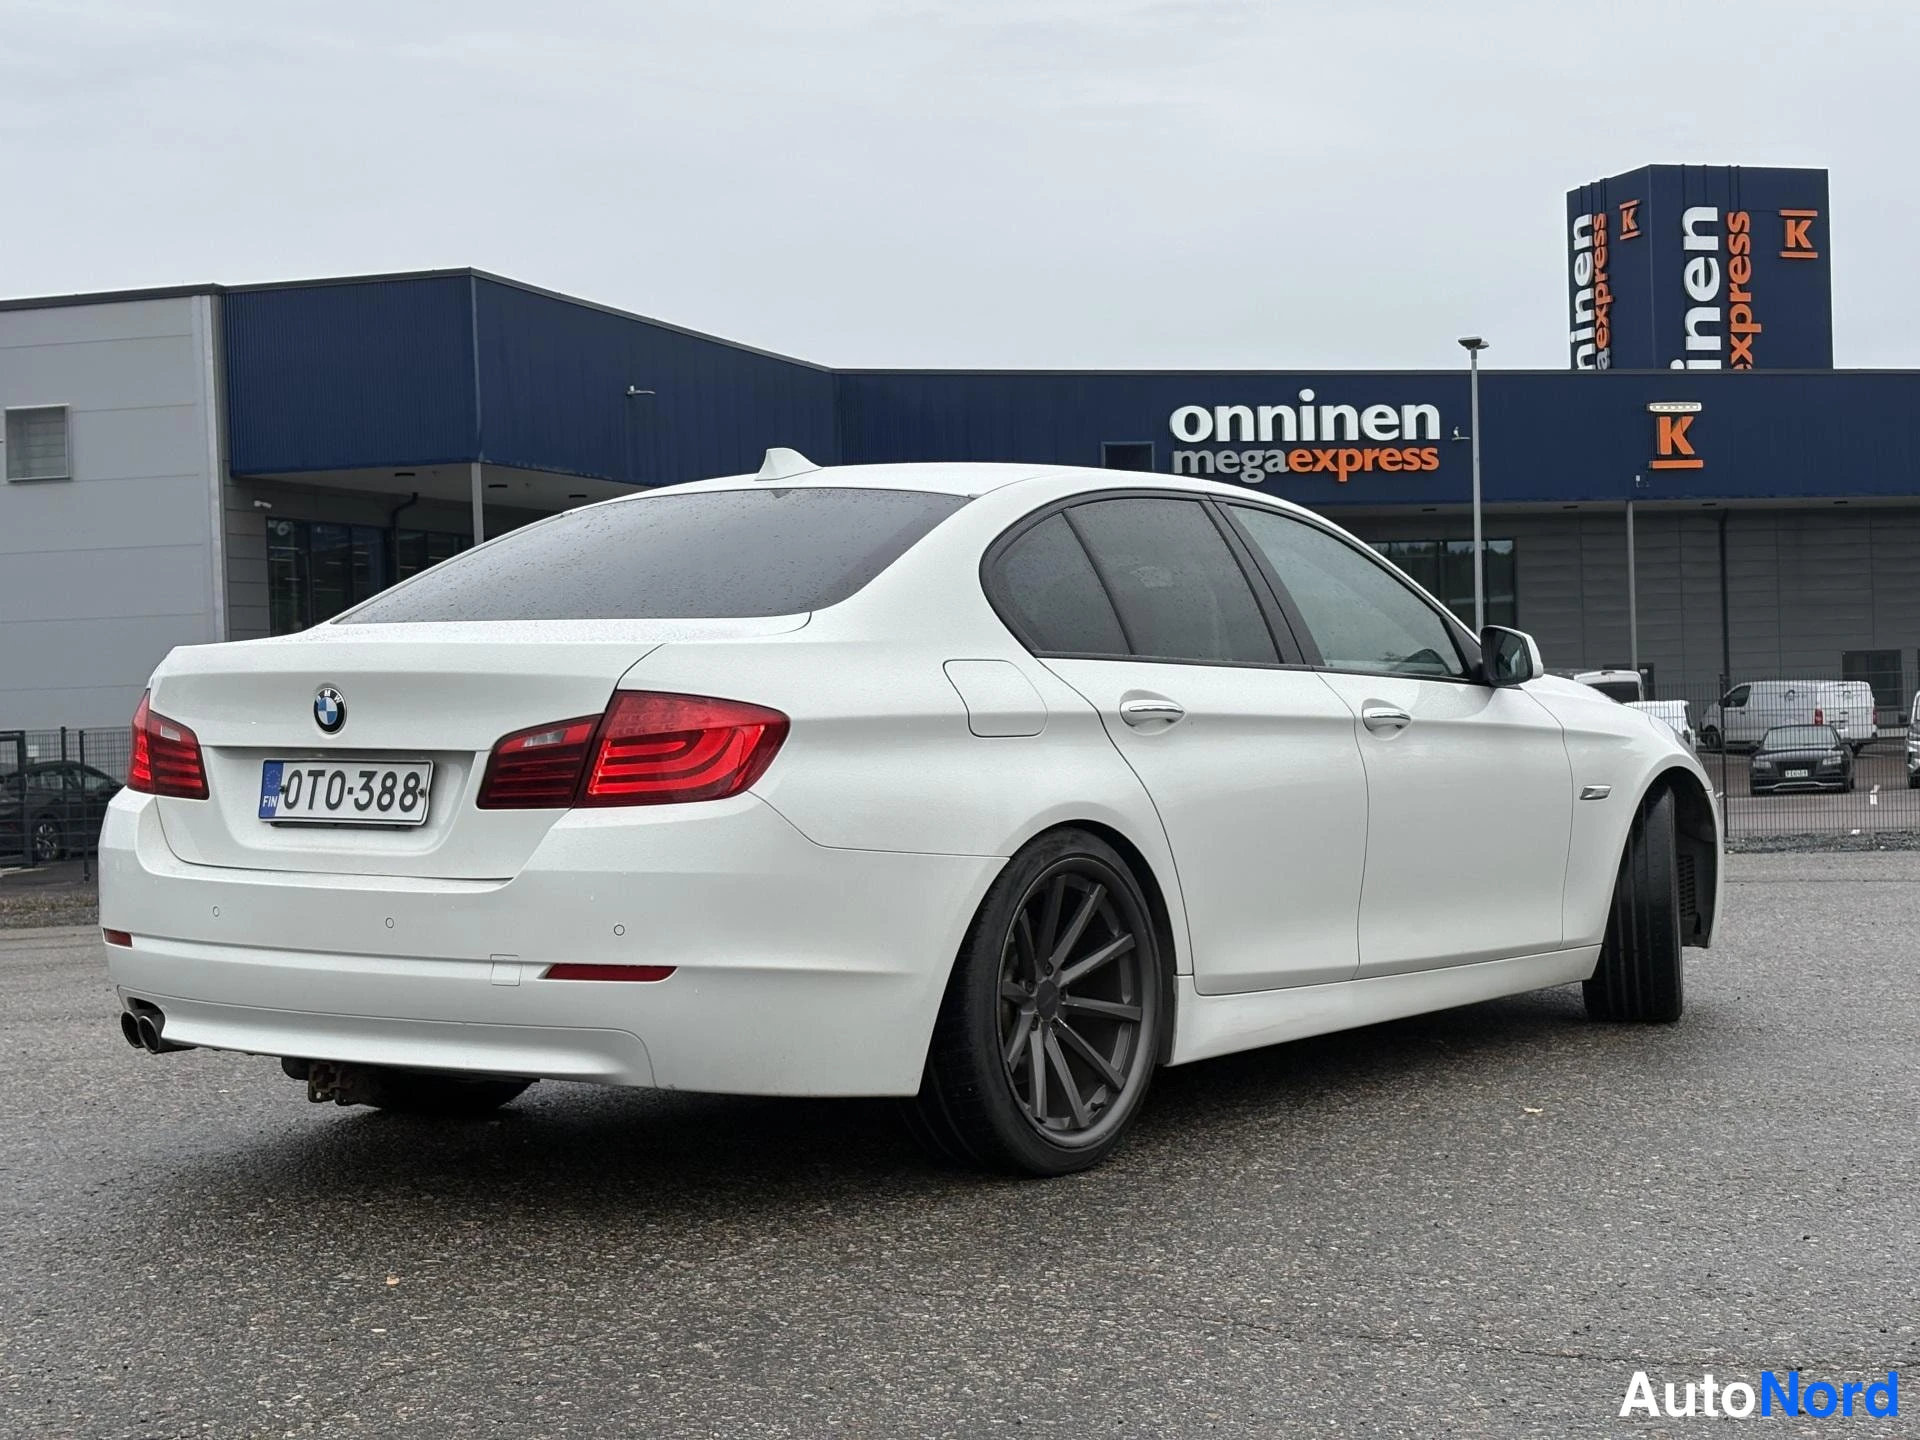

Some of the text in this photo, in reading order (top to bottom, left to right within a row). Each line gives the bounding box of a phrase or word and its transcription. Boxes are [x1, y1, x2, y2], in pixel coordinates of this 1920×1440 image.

[1622, 207, 1638, 231] K
[1785, 219, 1813, 248] K
[1727, 211, 1762, 369] xpress
[1169, 388, 1441, 443] onninen
[1656, 415, 1695, 455] K
[262, 795, 277, 807] FIN
[283, 769, 421, 813] OTO-388
